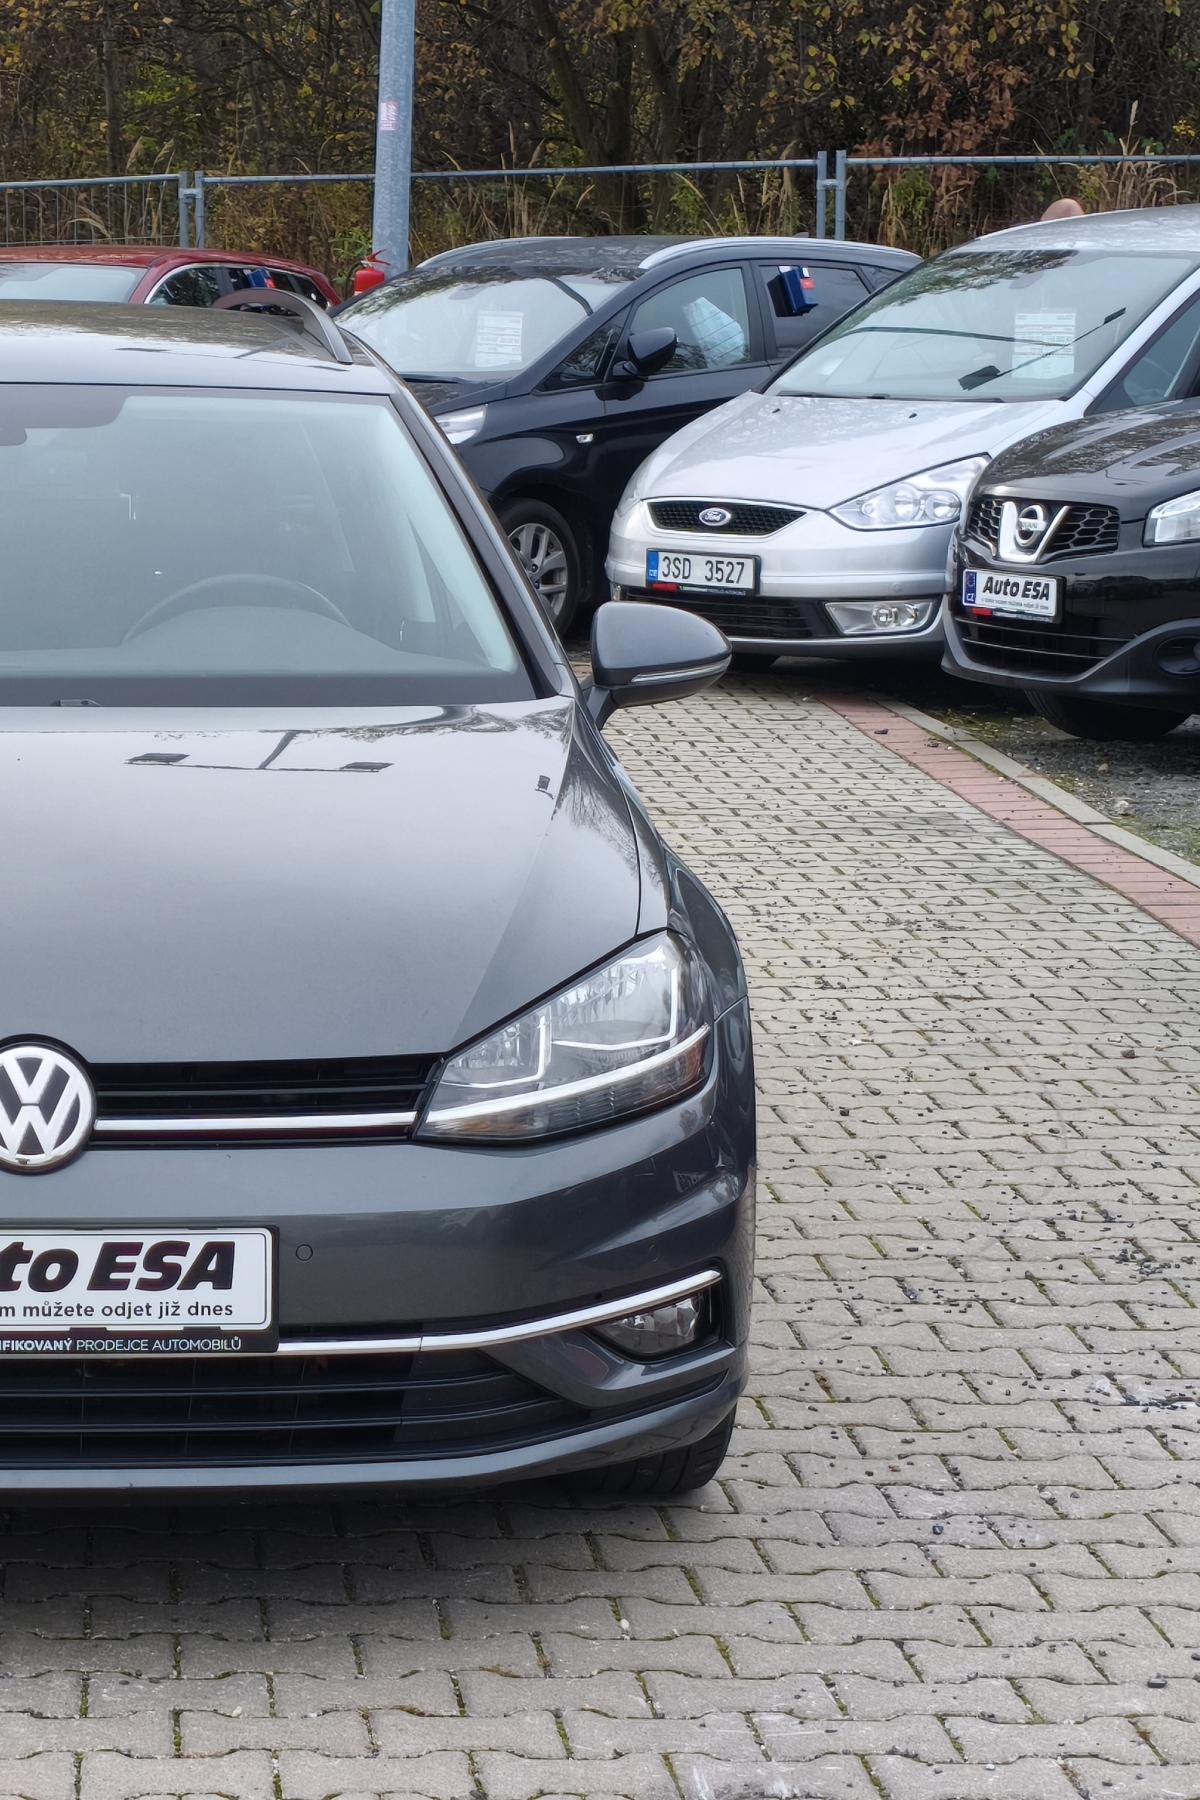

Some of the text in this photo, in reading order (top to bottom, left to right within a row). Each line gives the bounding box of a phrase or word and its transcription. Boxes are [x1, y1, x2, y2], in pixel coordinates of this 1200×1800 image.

[662, 556, 745, 583] 3SD 3527
[983, 576, 1050, 601] Auto ESA
[87, 1241, 235, 1291] ESA
[23, 1300, 94, 1317] můžete
[102, 1301, 152, 1319] odjet
[158, 1301, 181, 1319] již
[187, 1301, 233, 1316] dnes
[76, 1339, 148, 1351] PRODEJCE
[152, 1336, 241, 1350] AUTOMOBILŮ
